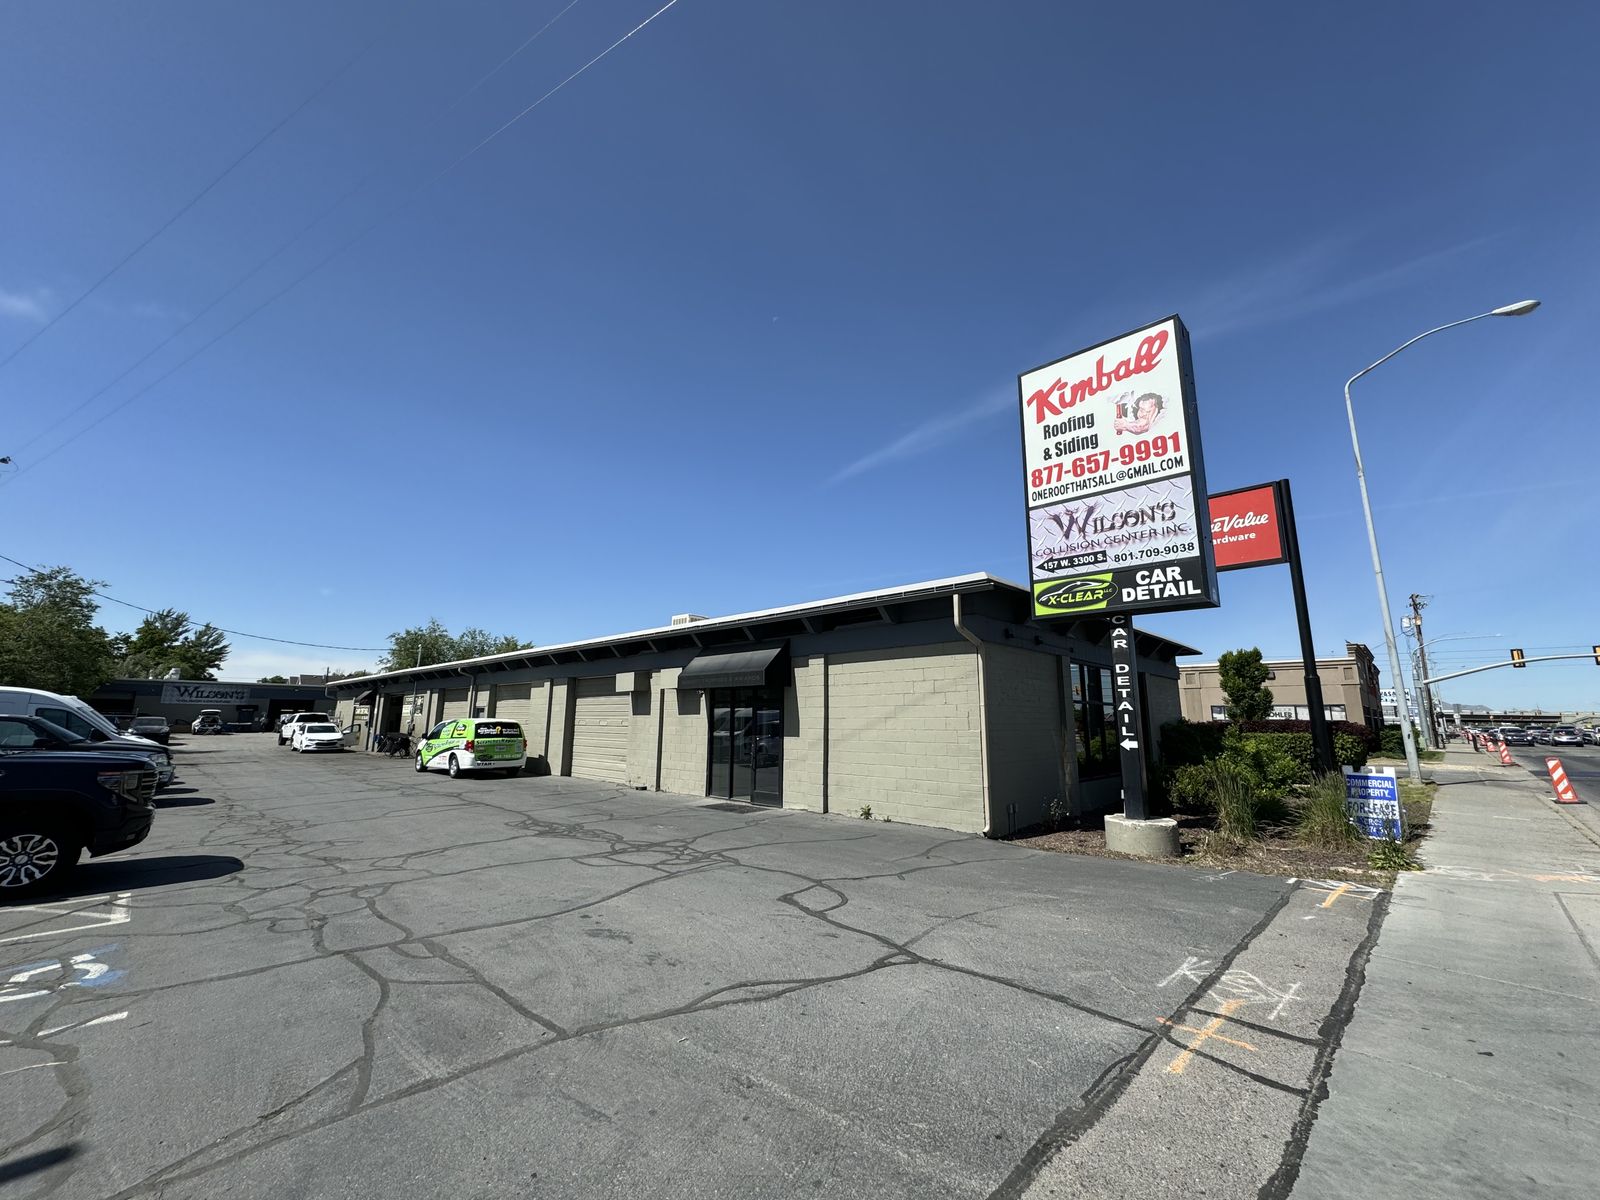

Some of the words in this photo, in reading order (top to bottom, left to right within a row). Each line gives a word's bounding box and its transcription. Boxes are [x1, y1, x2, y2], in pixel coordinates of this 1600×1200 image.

[1026, 330, 1169, 424] Kimball
[1043, 412, 1095, 440] Roofing
[1043, 447, 1053, 461] &
[1054, 432, 1099, 458] Siding
[1031, 431, 1181, 488] 877-657-9991
[1031, 455, 1184, 502] ONEROOFTHATSALL@GMAIL.COM
[1035, 538, 1101, 557] COLLISION
[1103, 527, 1160, 545] CENTER
[1161, 522, 1192, 535] INC.
[1212, 532, 1256, 545] ardware
[1043, 560, 1058, 570] 157
[1060, 558, 1072, 568] W.
[1073, 555, 1095, 565] 3300
[1097, 553, 1107, 562] S.
[1114, 542, 1195, 563] 801.709-9038
[1135, 566, 1183, 585] CAR
[1048, 589, 1105, 605] X-CLEAR
[1121, 580, 1202, 602] DETAIL
[1111, 615, 1128, 649] CAR
[1115, 664, 1135, 736] DETAIL
[1267, 711, 1293, 719] OHLER
[1346, 779, 1393, 788] COMMERCIAL
